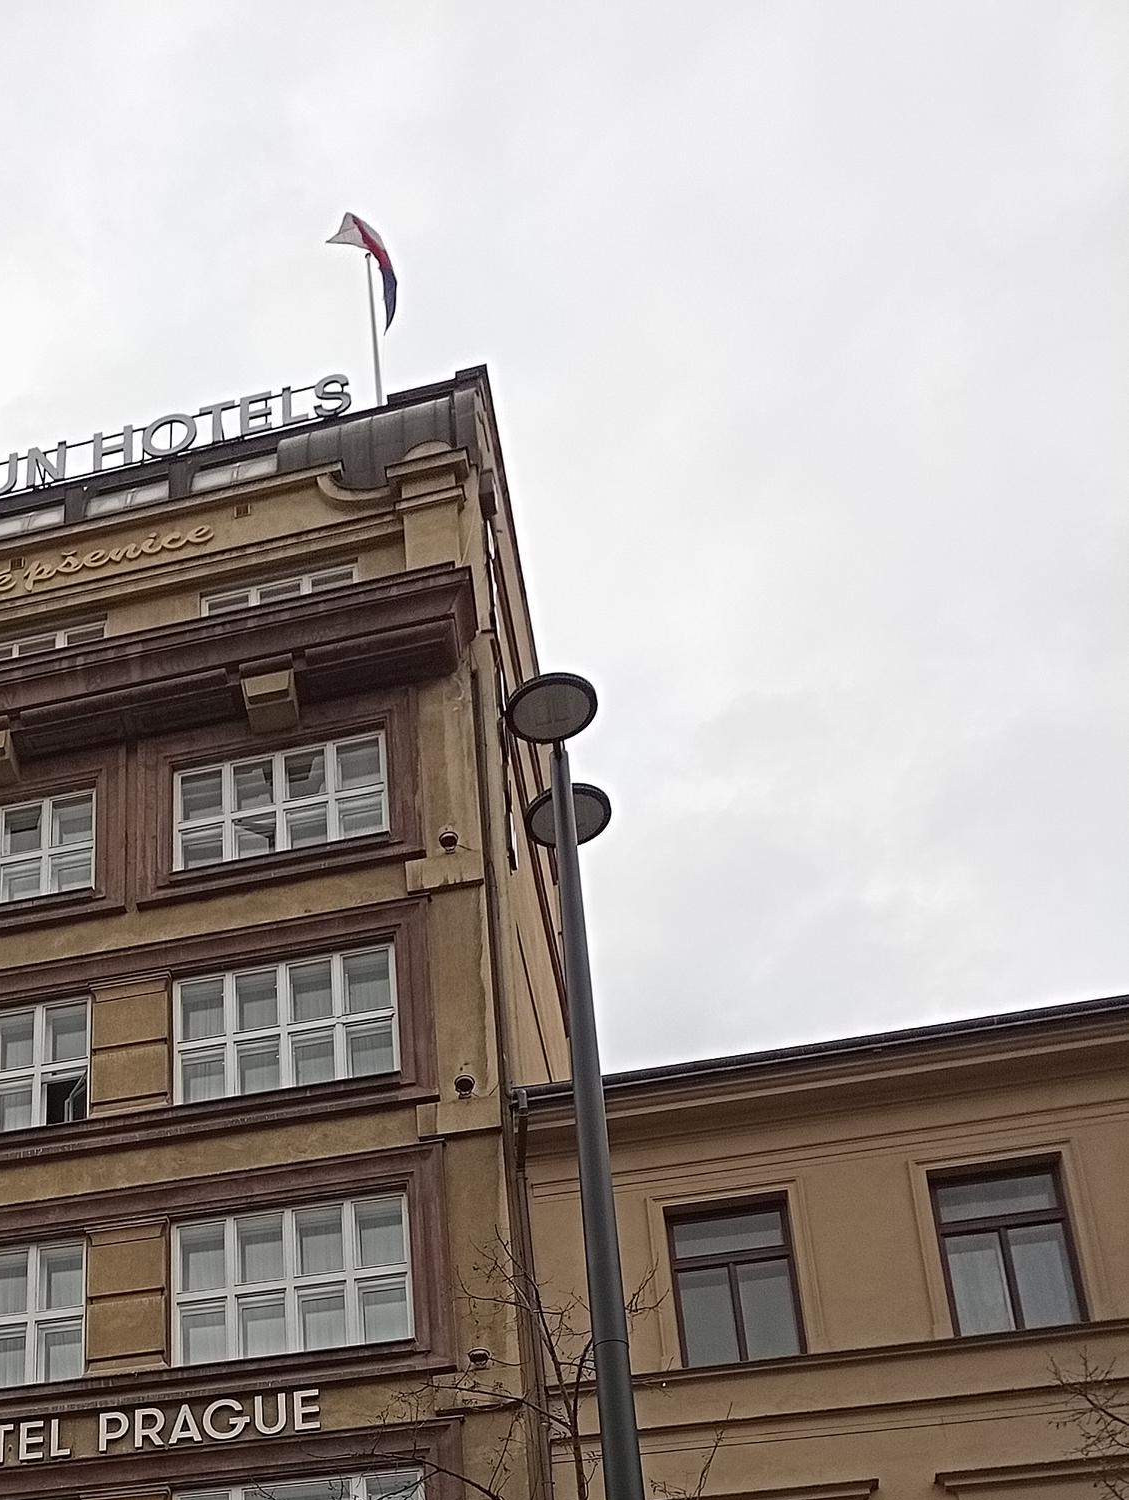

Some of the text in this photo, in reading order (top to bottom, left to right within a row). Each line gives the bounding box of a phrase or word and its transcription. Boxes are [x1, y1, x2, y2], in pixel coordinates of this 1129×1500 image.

[92, 374, 352, 472] HOTELS
[21, 522, 215, 593] pšenice
[97, 1389, 321, 1453] PRAGUE
